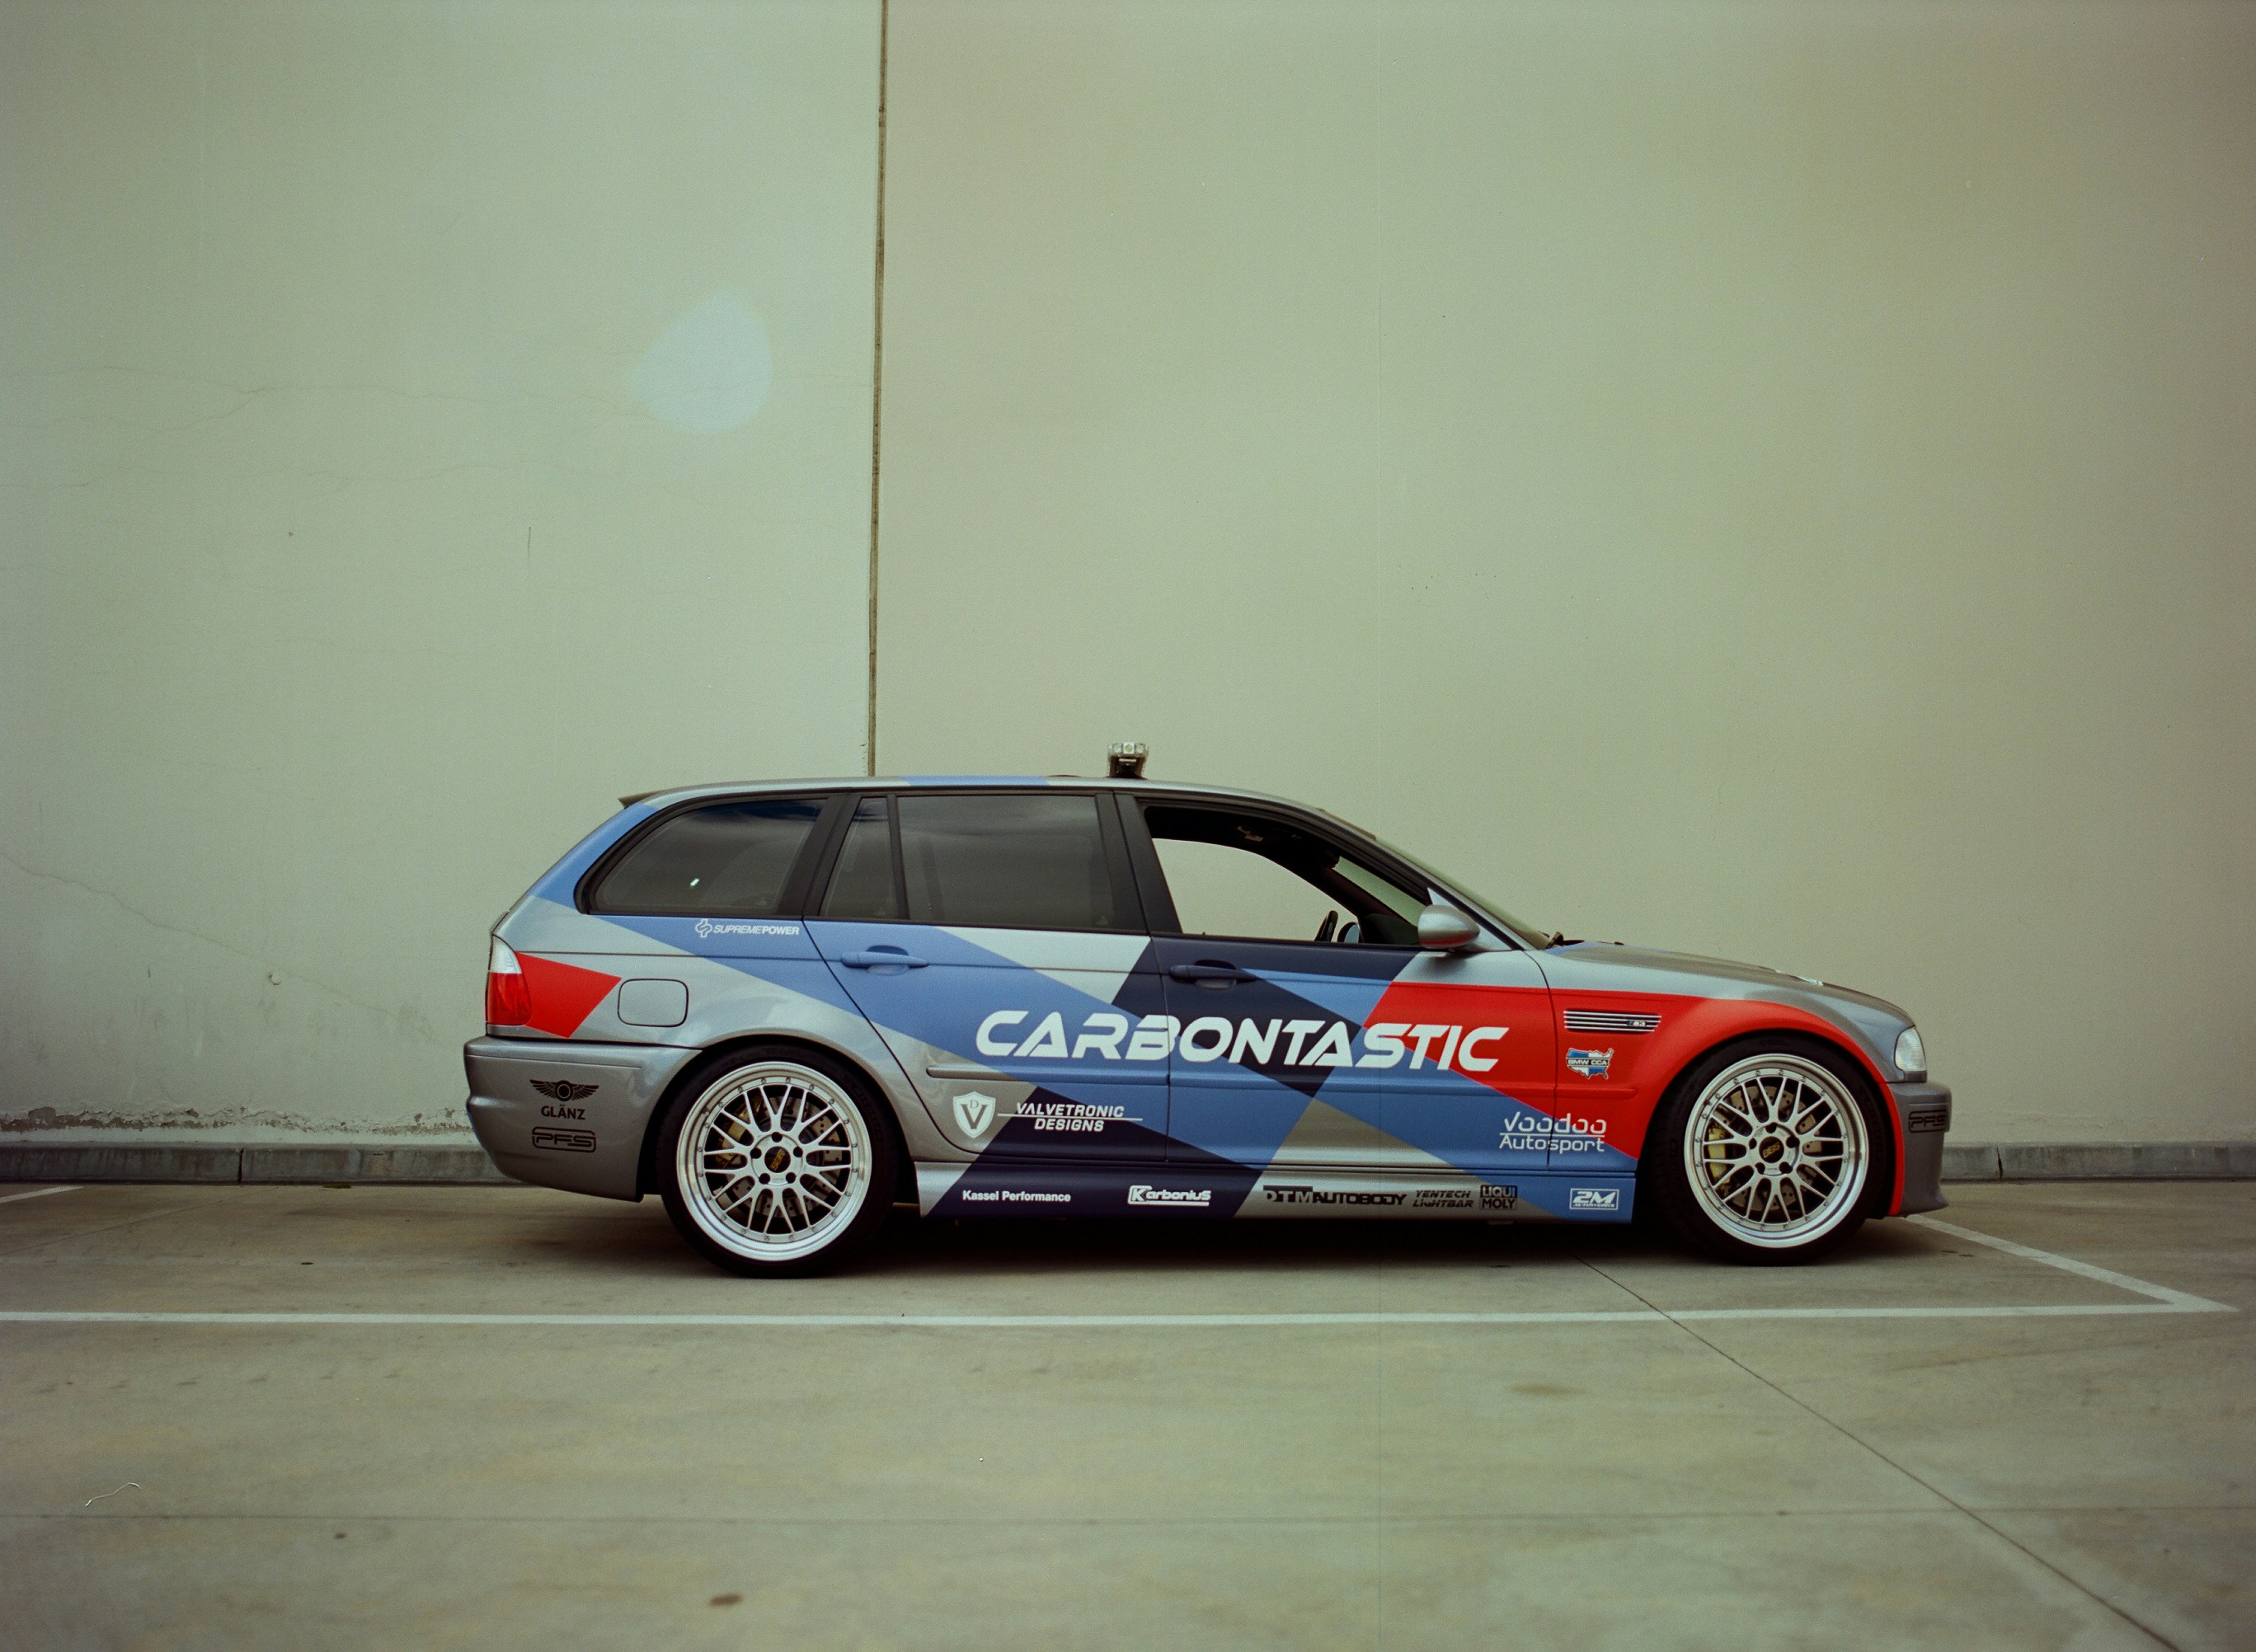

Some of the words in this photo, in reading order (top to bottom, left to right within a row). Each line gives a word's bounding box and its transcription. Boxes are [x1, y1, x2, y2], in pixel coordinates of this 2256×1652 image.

[714, 924, 800, 936] SUPREMEPOWER
[975, 1010, 1510, 1072] CARBONTASTIC
[541, 1104, 586, 1120] GLÄNZ
[1017, 1102, 1126, 1118] VALVETRONIC
[1034, 1118, 1105, 1133] DESIGNS
[1504, 1111, 1607, 1134] Voodoo
[532, 1130, 595, 1148] PFS
[1499, 1134, 1605, 1154] Autosport
[962, 1190, 999, 1201] Kassel
[1002, 1190, 1071, 1202] Performance
[1482, 1185, 1516, 1197] LIQUI
[1572, 1190, 1616, 1204] 2M
[1482, 1198, 1516, 1208] MOLY
